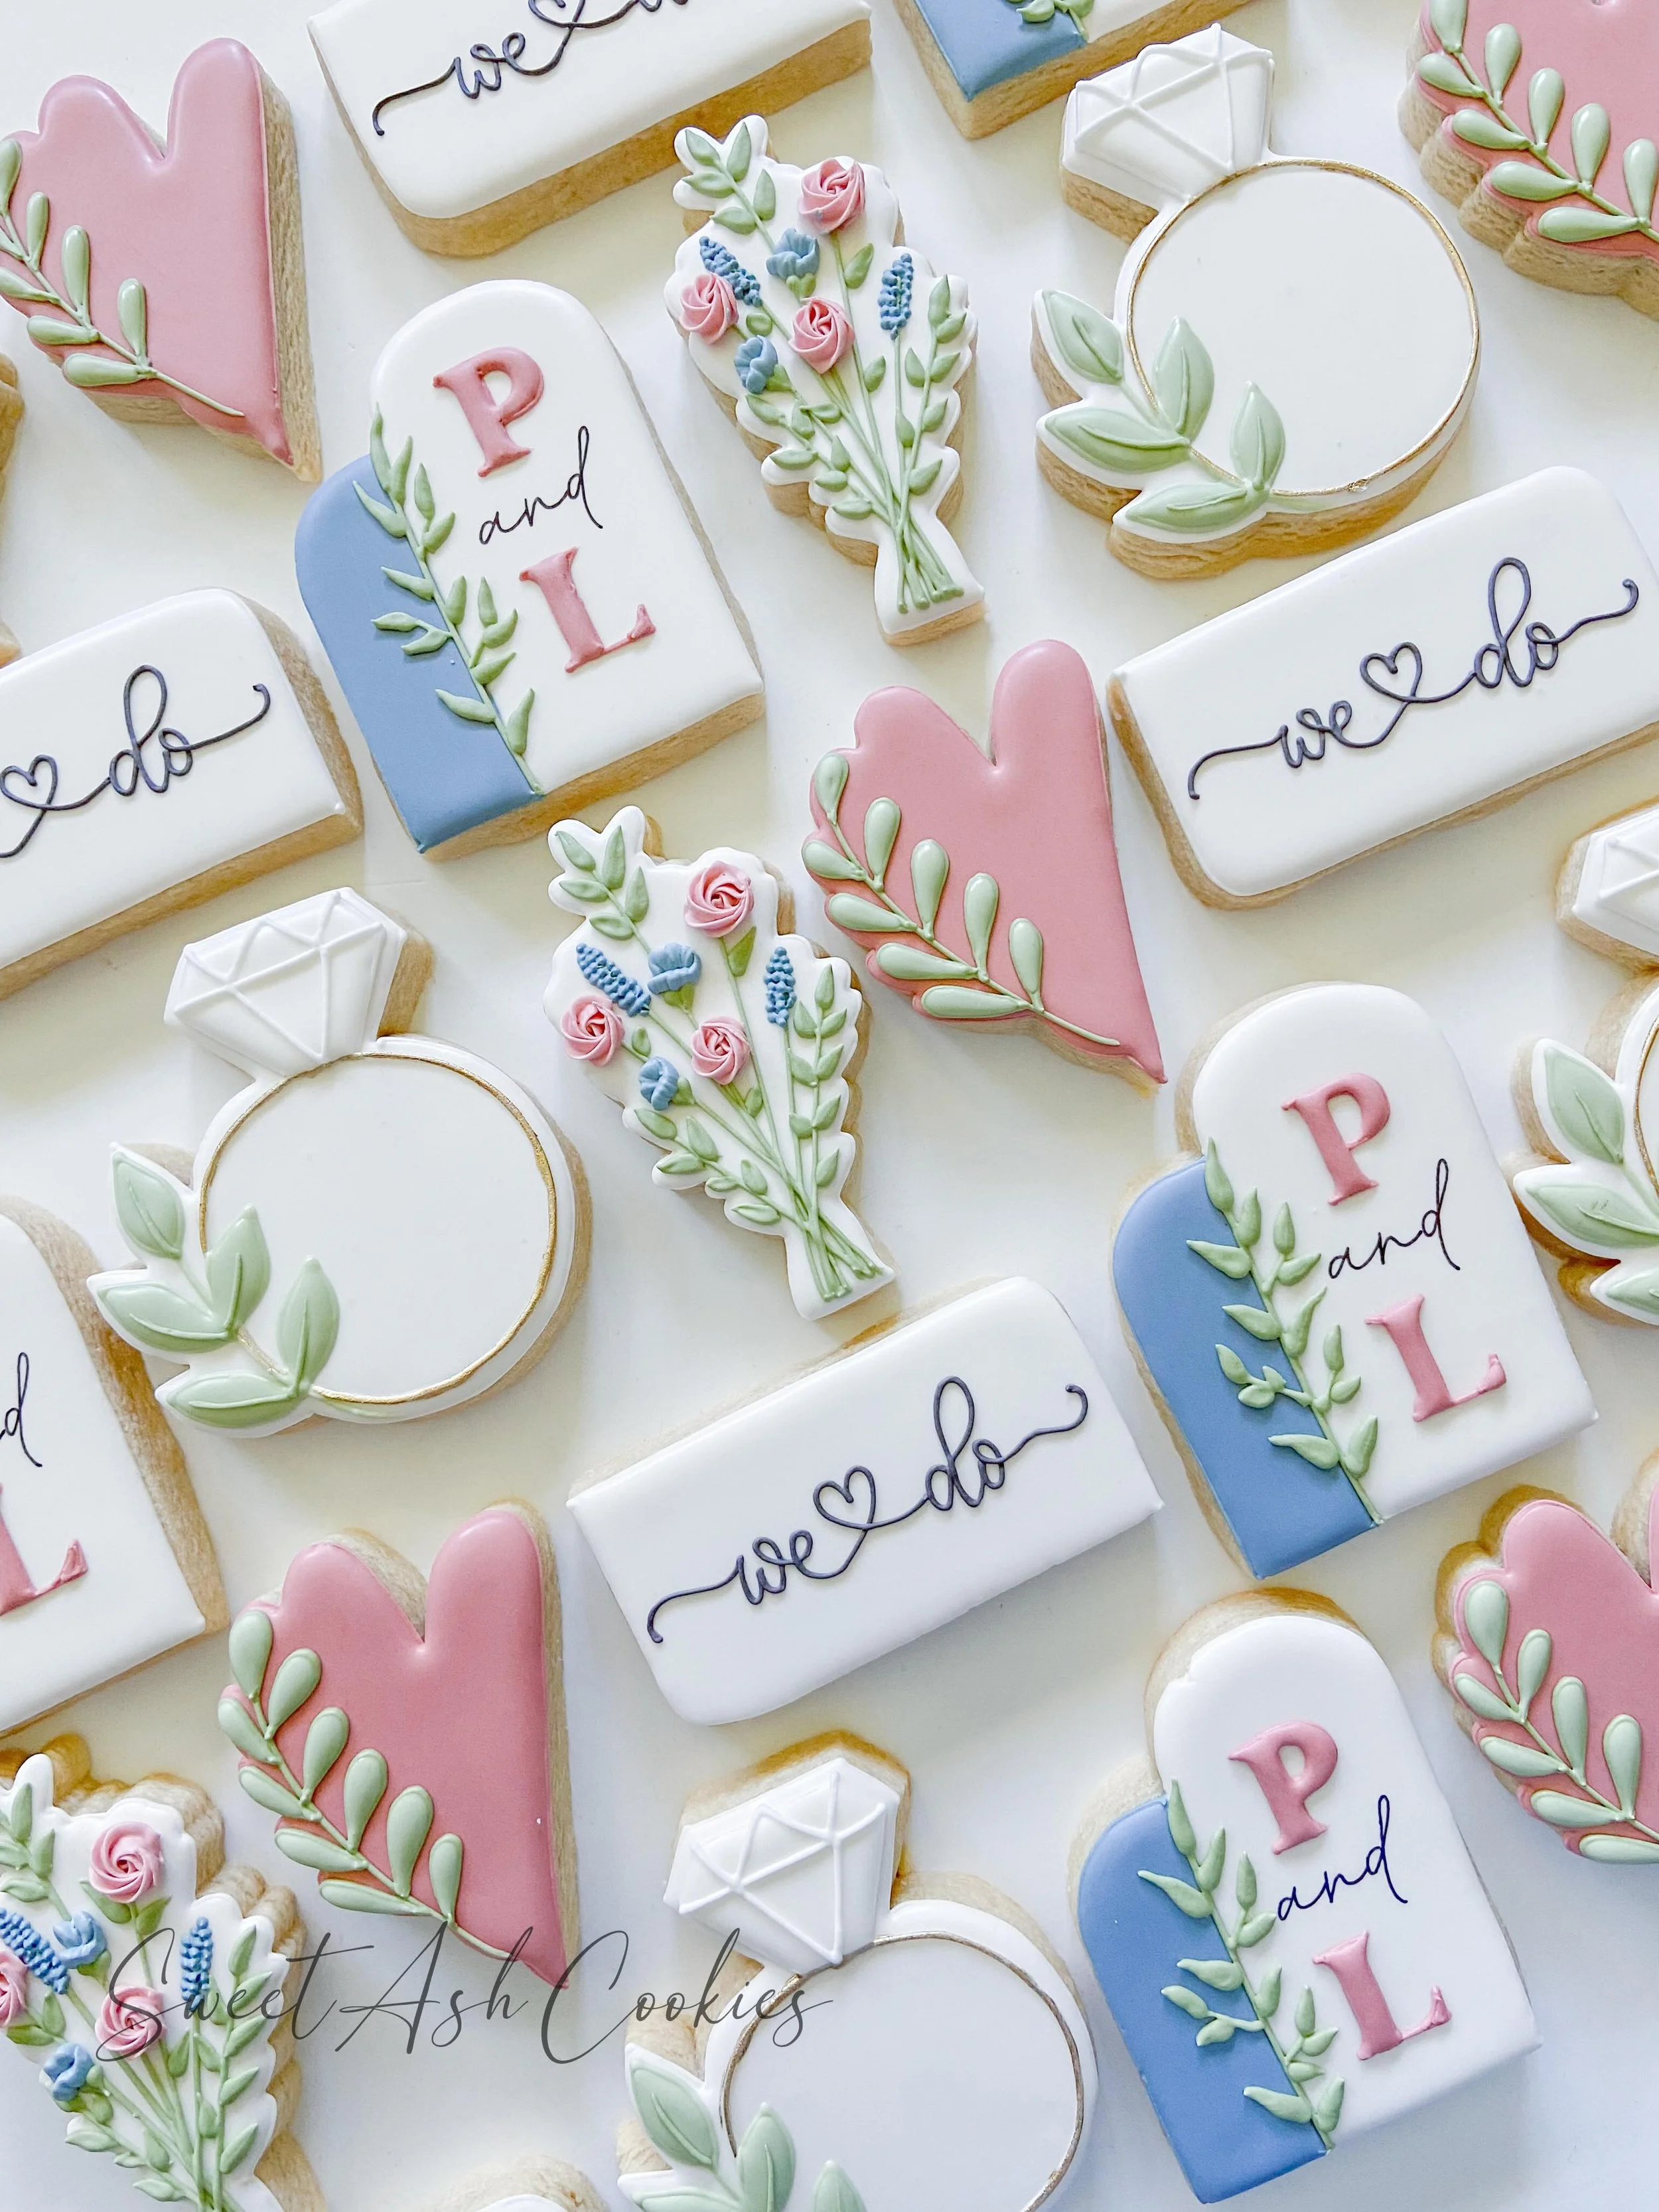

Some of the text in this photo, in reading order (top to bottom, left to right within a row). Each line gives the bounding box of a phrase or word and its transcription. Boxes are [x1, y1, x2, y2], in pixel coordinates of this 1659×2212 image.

[433, 346, 545, 478] P
[478, 425, 603, 544] and
[519, 546, 657, 674] L
[1474, 557, 1639, 688] do
[109, 664, 271, 796] do
[1281, 1072, 1391, 1207] P
[1328, 1158, 1461, 1278] and
[1364, 1292, 1507, 1422] L
[926, 1375, 1088, 1511] do
[1228, 1719, 1339, 1855] P
[1277, 1794, 1408, 1921] and
[1312, 1930, 1453, 2061] L
